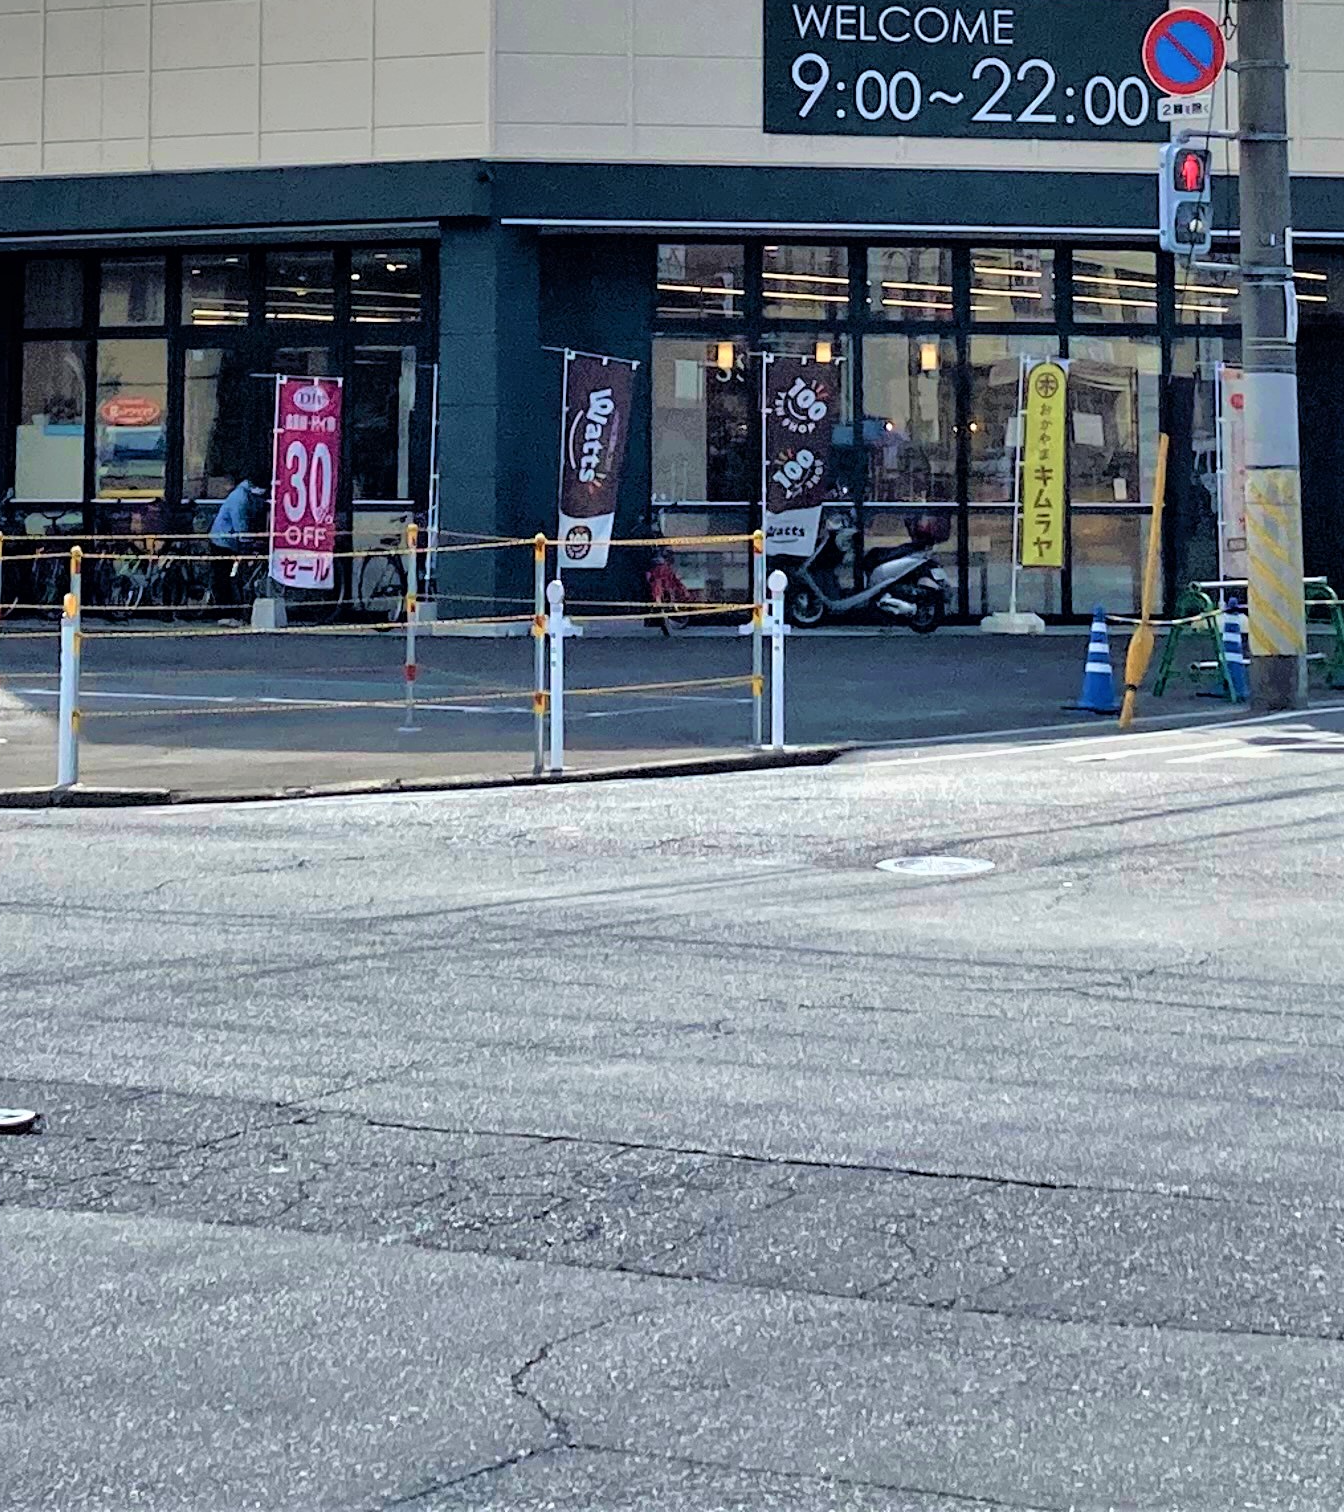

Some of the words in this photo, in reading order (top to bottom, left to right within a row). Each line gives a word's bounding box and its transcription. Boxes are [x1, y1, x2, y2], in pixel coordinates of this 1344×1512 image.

[792, 4, 1014, 45] WELCOME
[791, 53, 1150, 127] 9:00~22:00
[787, 377, 828, 422] 100
[578, 388, 615, 483] Watts
[773, 449, 815, 489] 100
[1033, 465, 1054, 558] キムラヤ
[285, 526, 327, 549] OFF
[281, 557, 331, 581] セール
